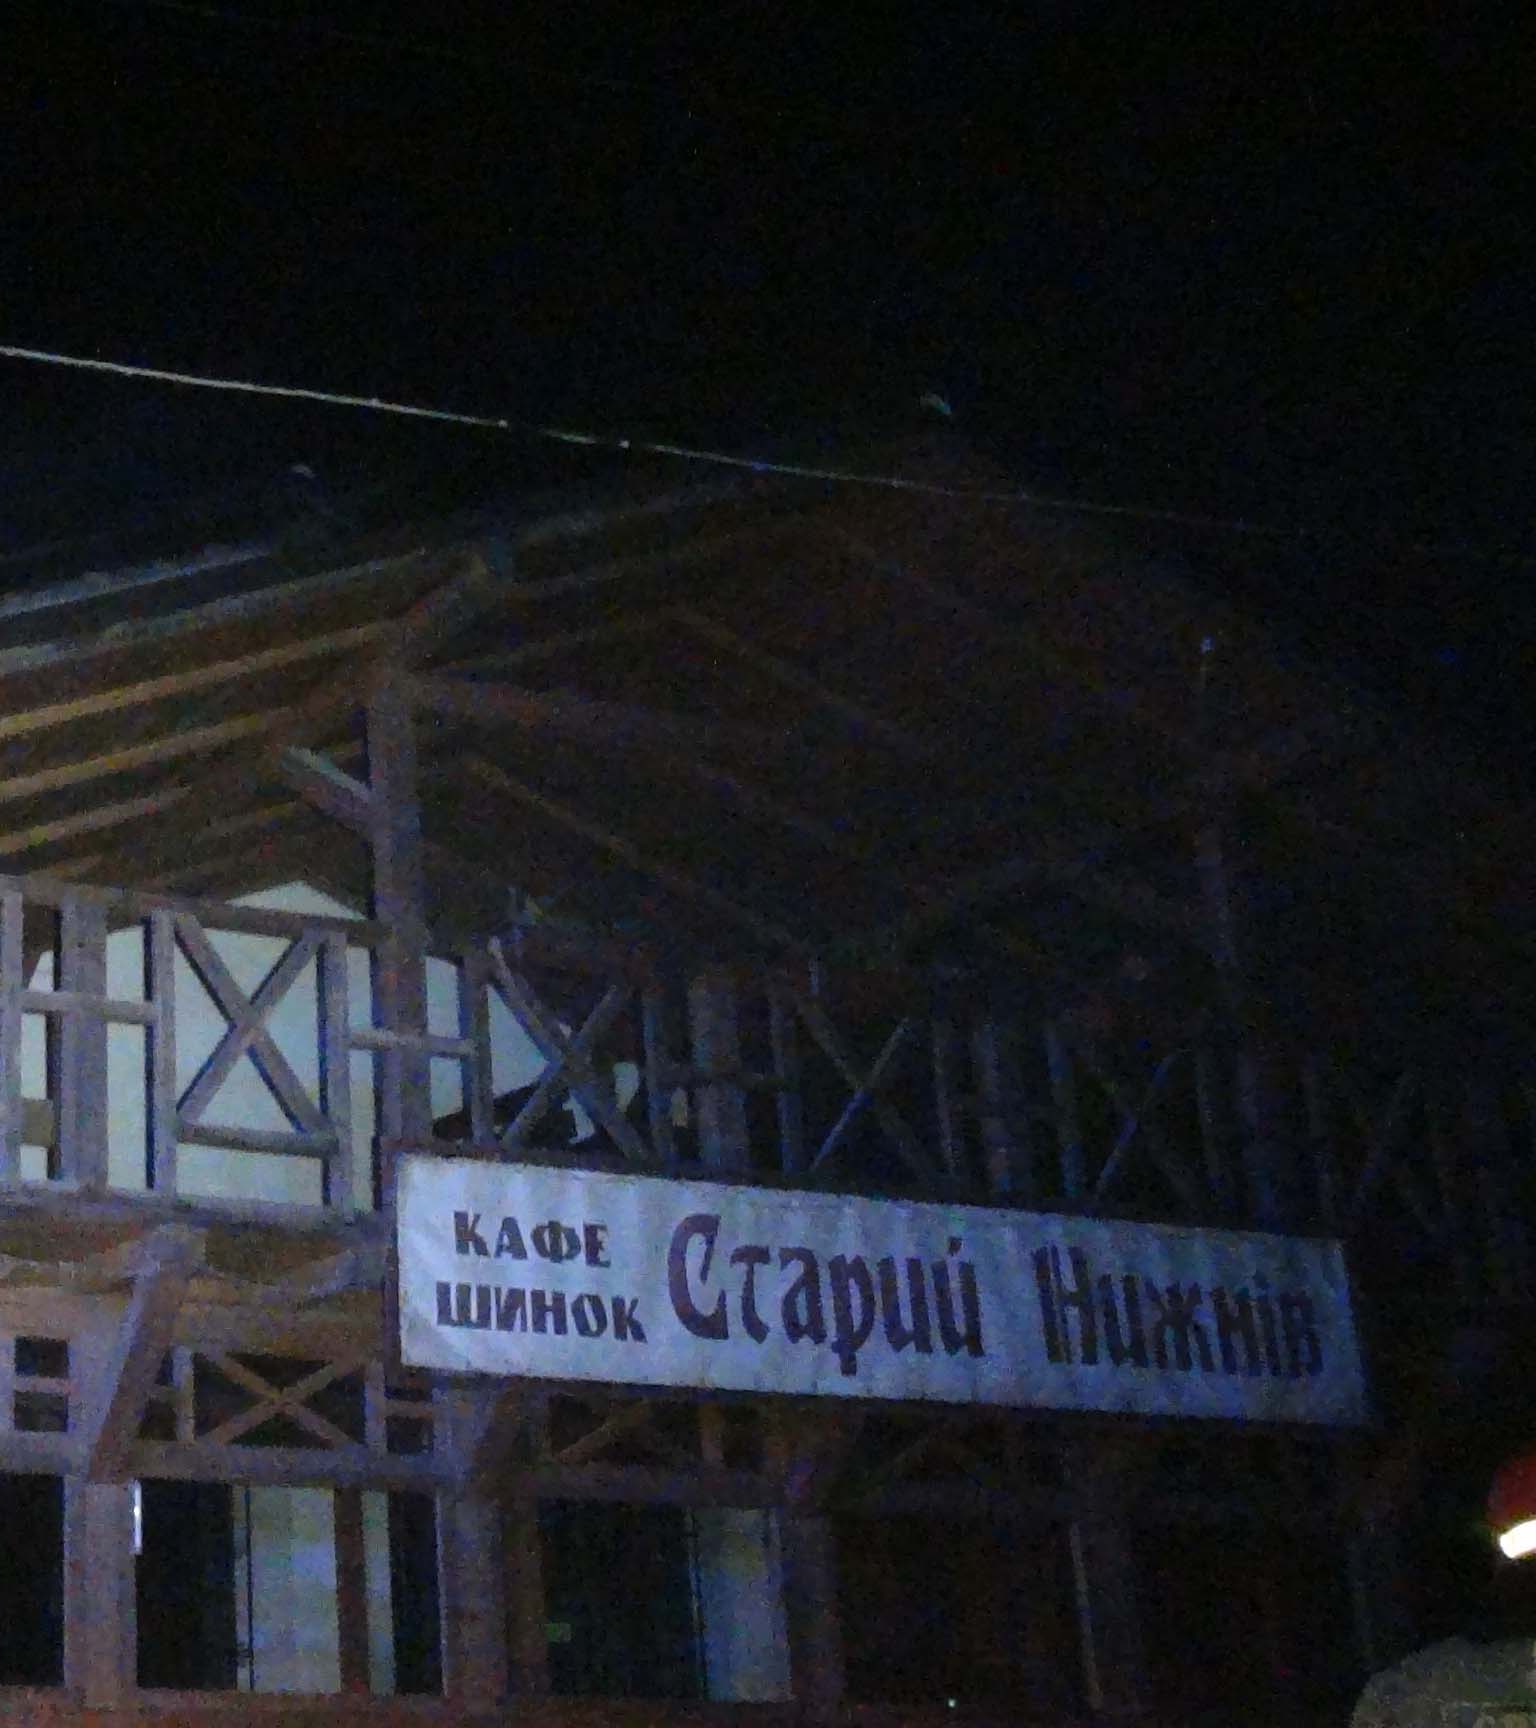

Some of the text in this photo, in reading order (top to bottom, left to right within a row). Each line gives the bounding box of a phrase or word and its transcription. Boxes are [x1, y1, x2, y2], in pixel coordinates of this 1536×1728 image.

[452, 1210, 612, 1268] КАФЕ
[434, 1281, 649, 1344] ШИНОК
[667, 1213, 985, 1377] Старий
